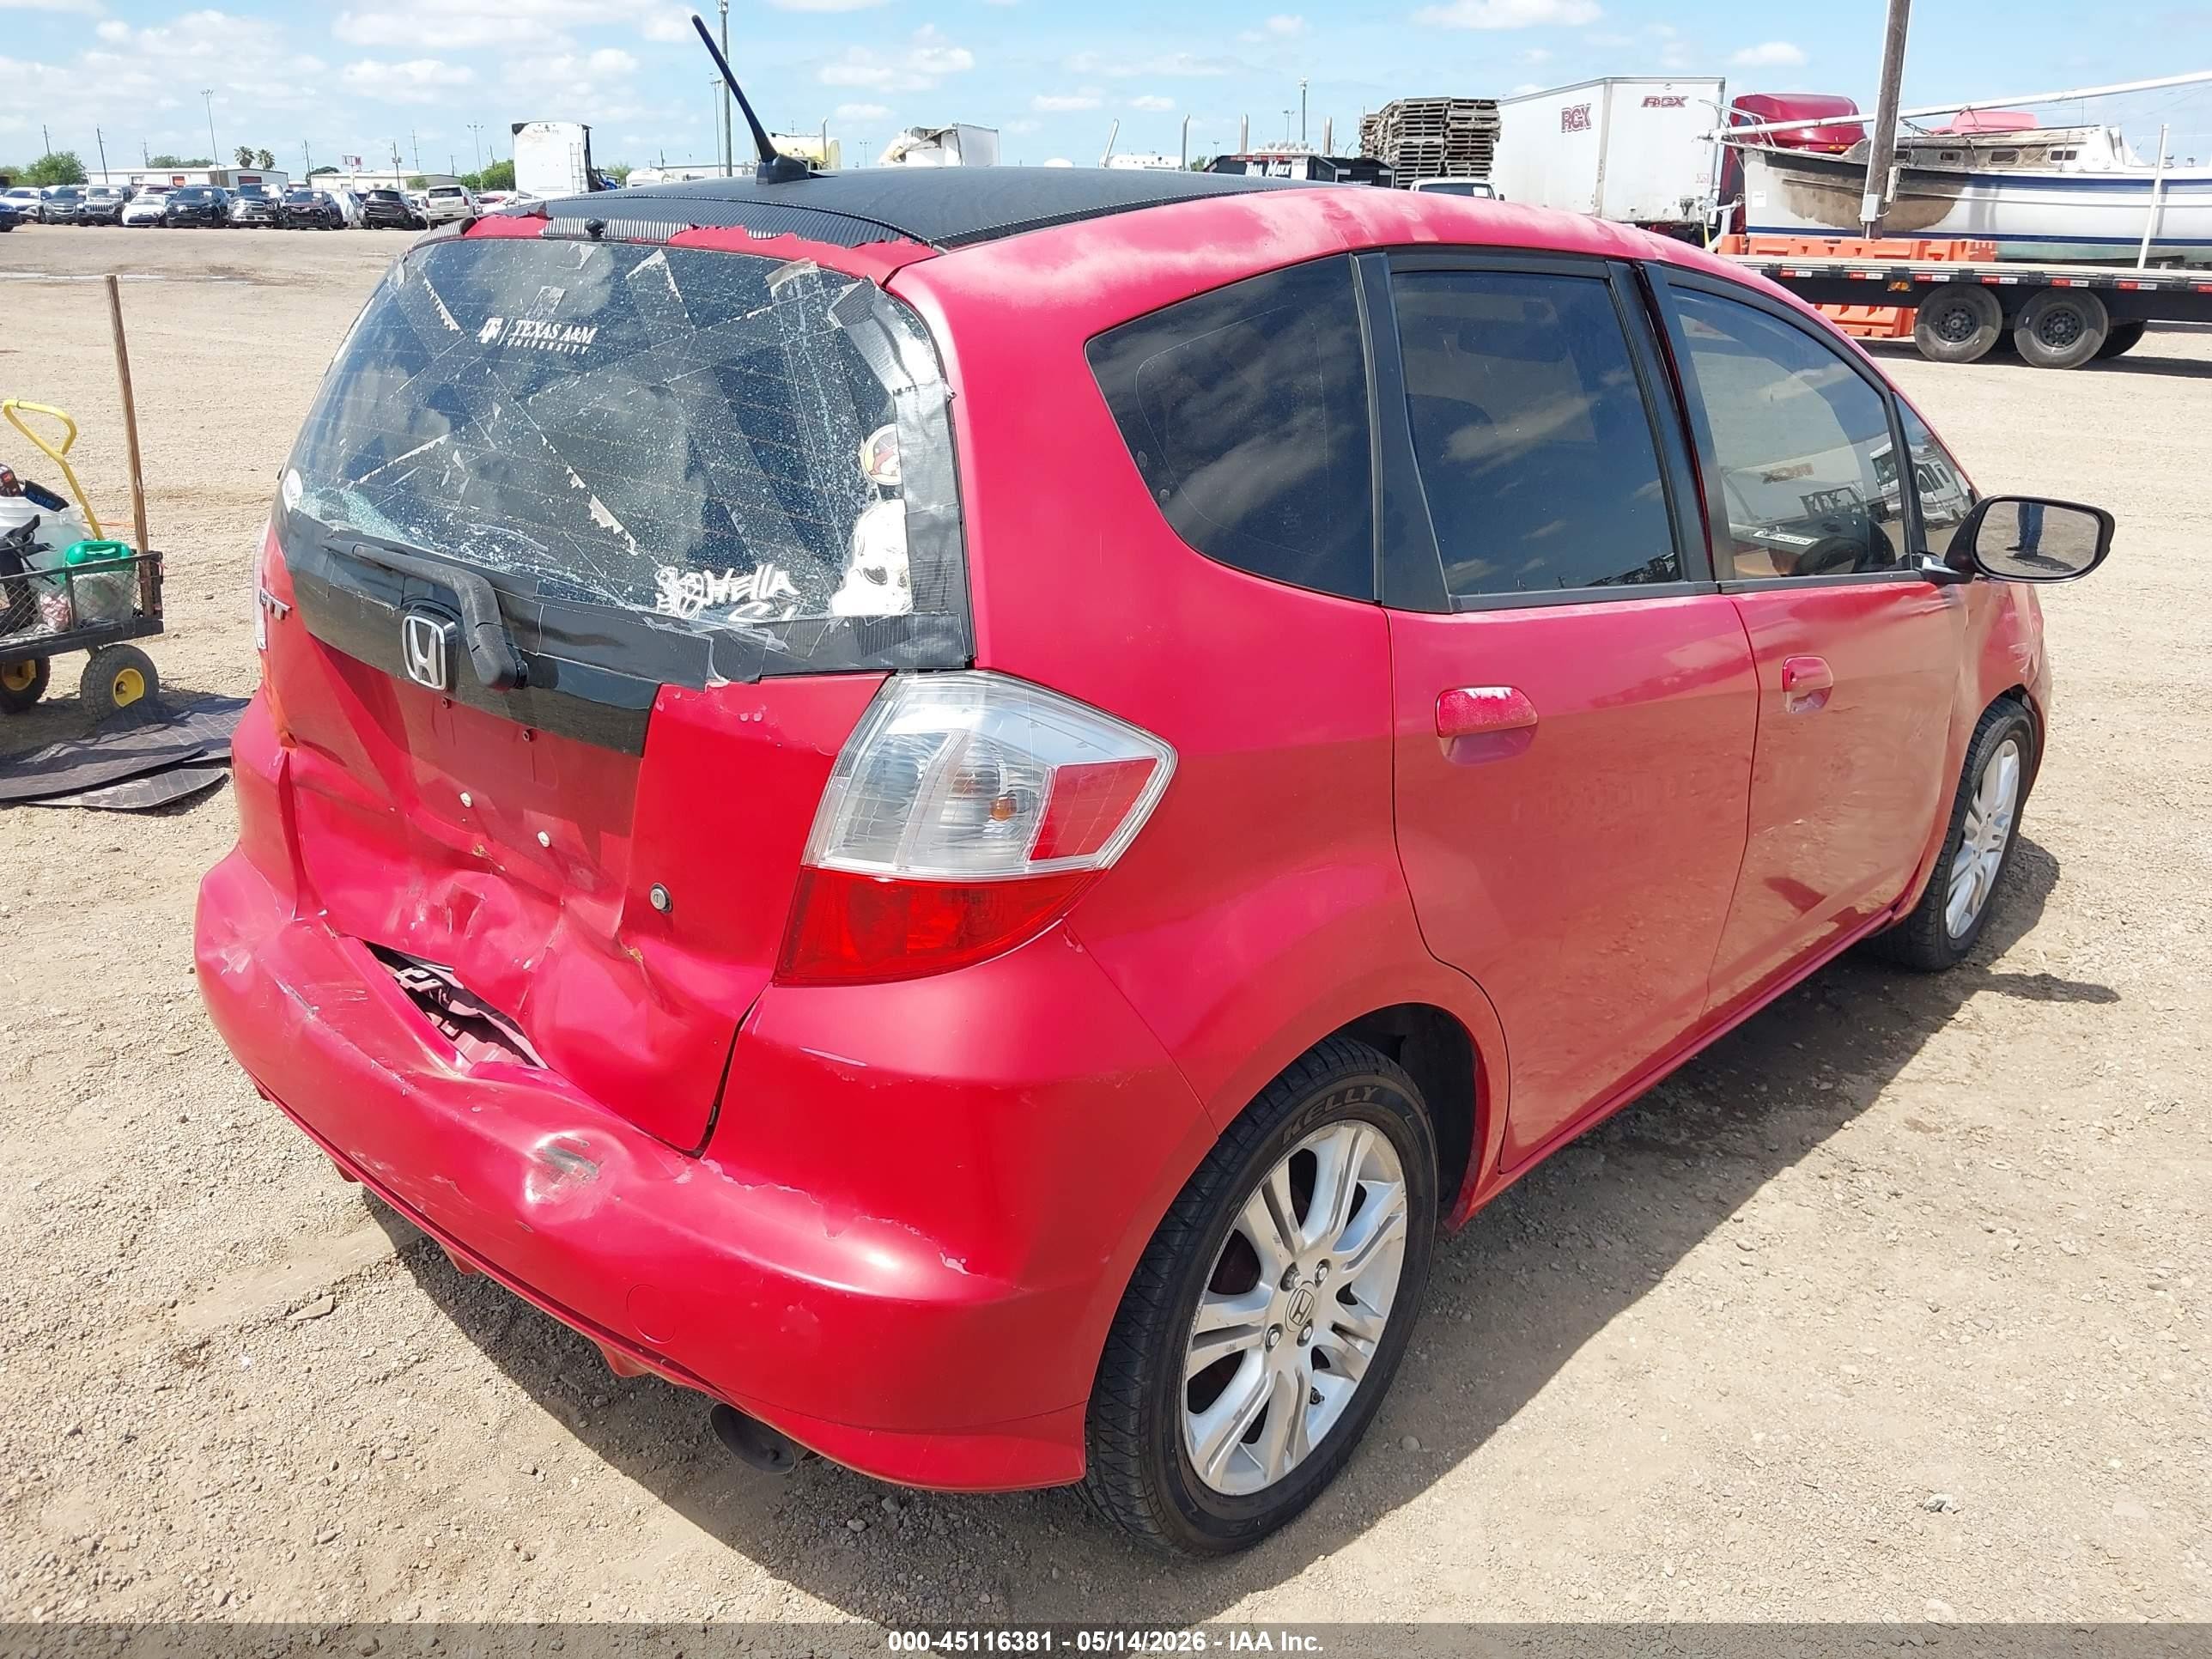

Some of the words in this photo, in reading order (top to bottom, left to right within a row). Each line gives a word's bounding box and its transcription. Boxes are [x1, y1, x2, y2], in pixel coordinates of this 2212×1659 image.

[511, 320, 561, 337] TEXAS
[562, 325, 598, 344] A&M
[507, 339, 589, 355] UNIVERSITY
[1282, 1085, 1380, 1145] KELLY
